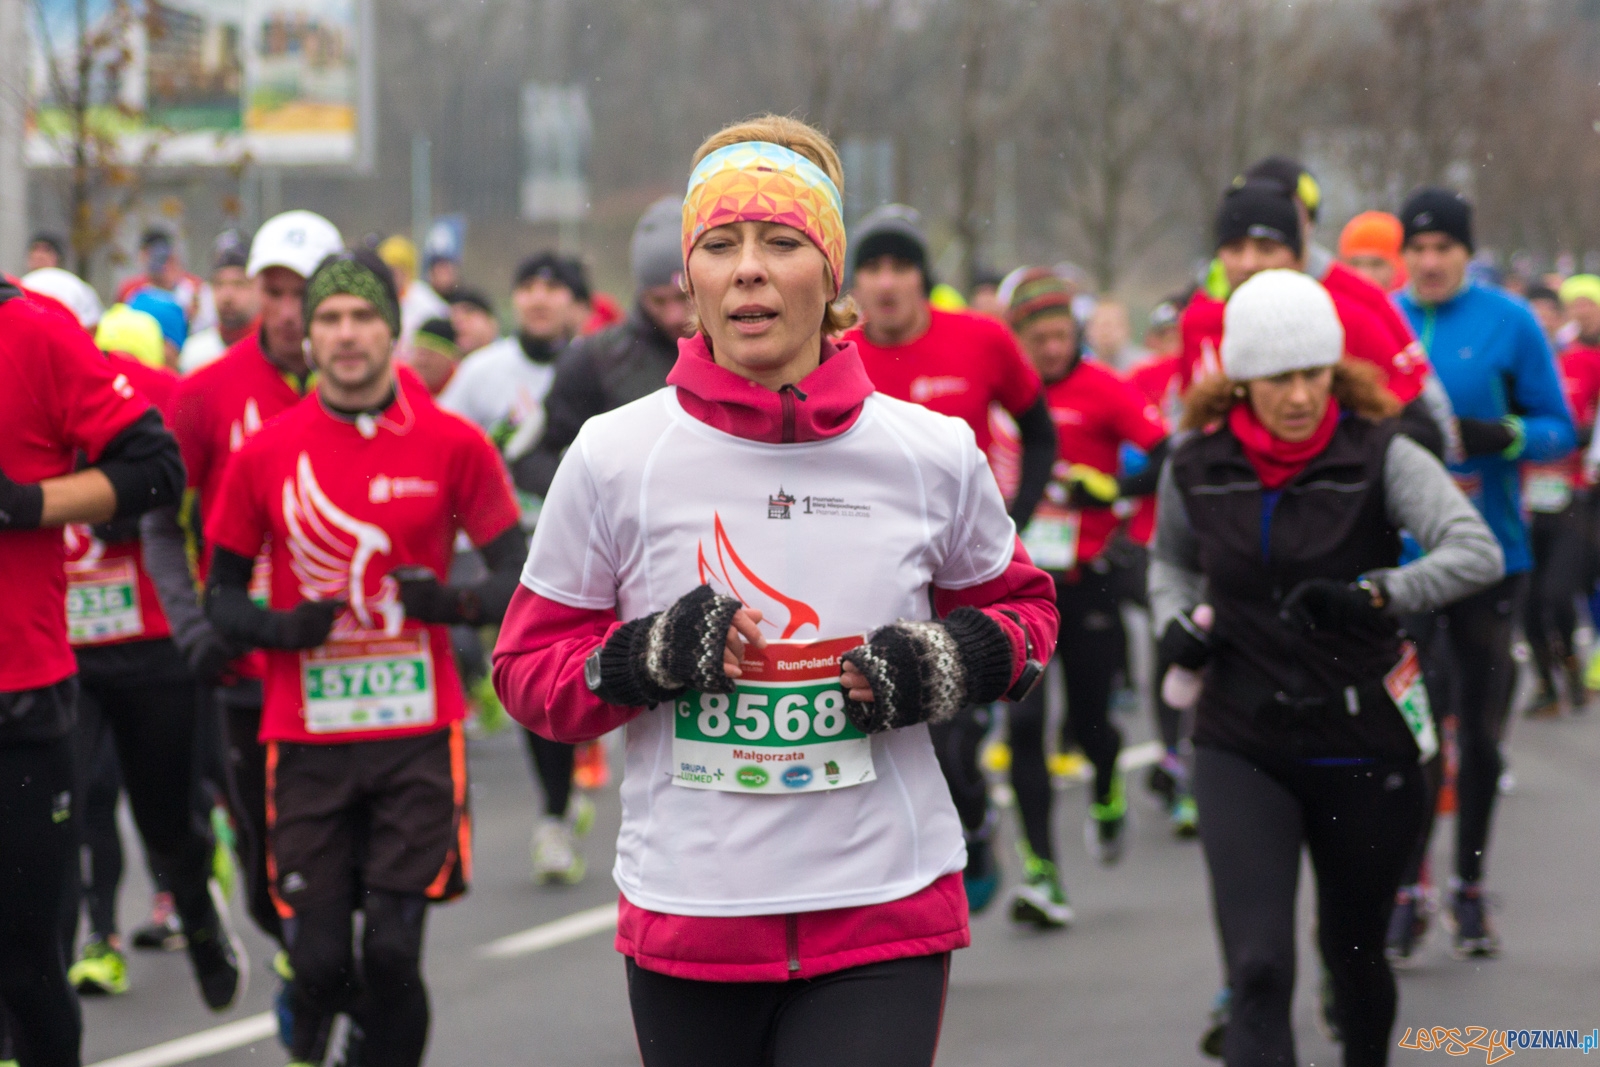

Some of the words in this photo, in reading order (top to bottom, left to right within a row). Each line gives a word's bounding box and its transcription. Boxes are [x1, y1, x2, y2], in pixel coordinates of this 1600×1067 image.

[802, 495, 813, 514] 1
[777, 655, 843, 671] RunPoland.c
[322, 662, 417, 697] 5702
[697, 689, 847, 742] 8568
[733, 749, 805, 763] Małgorzata
[681, 762, 707, 774] GRUPA
[680, 771, 713, 784] LUXMED
